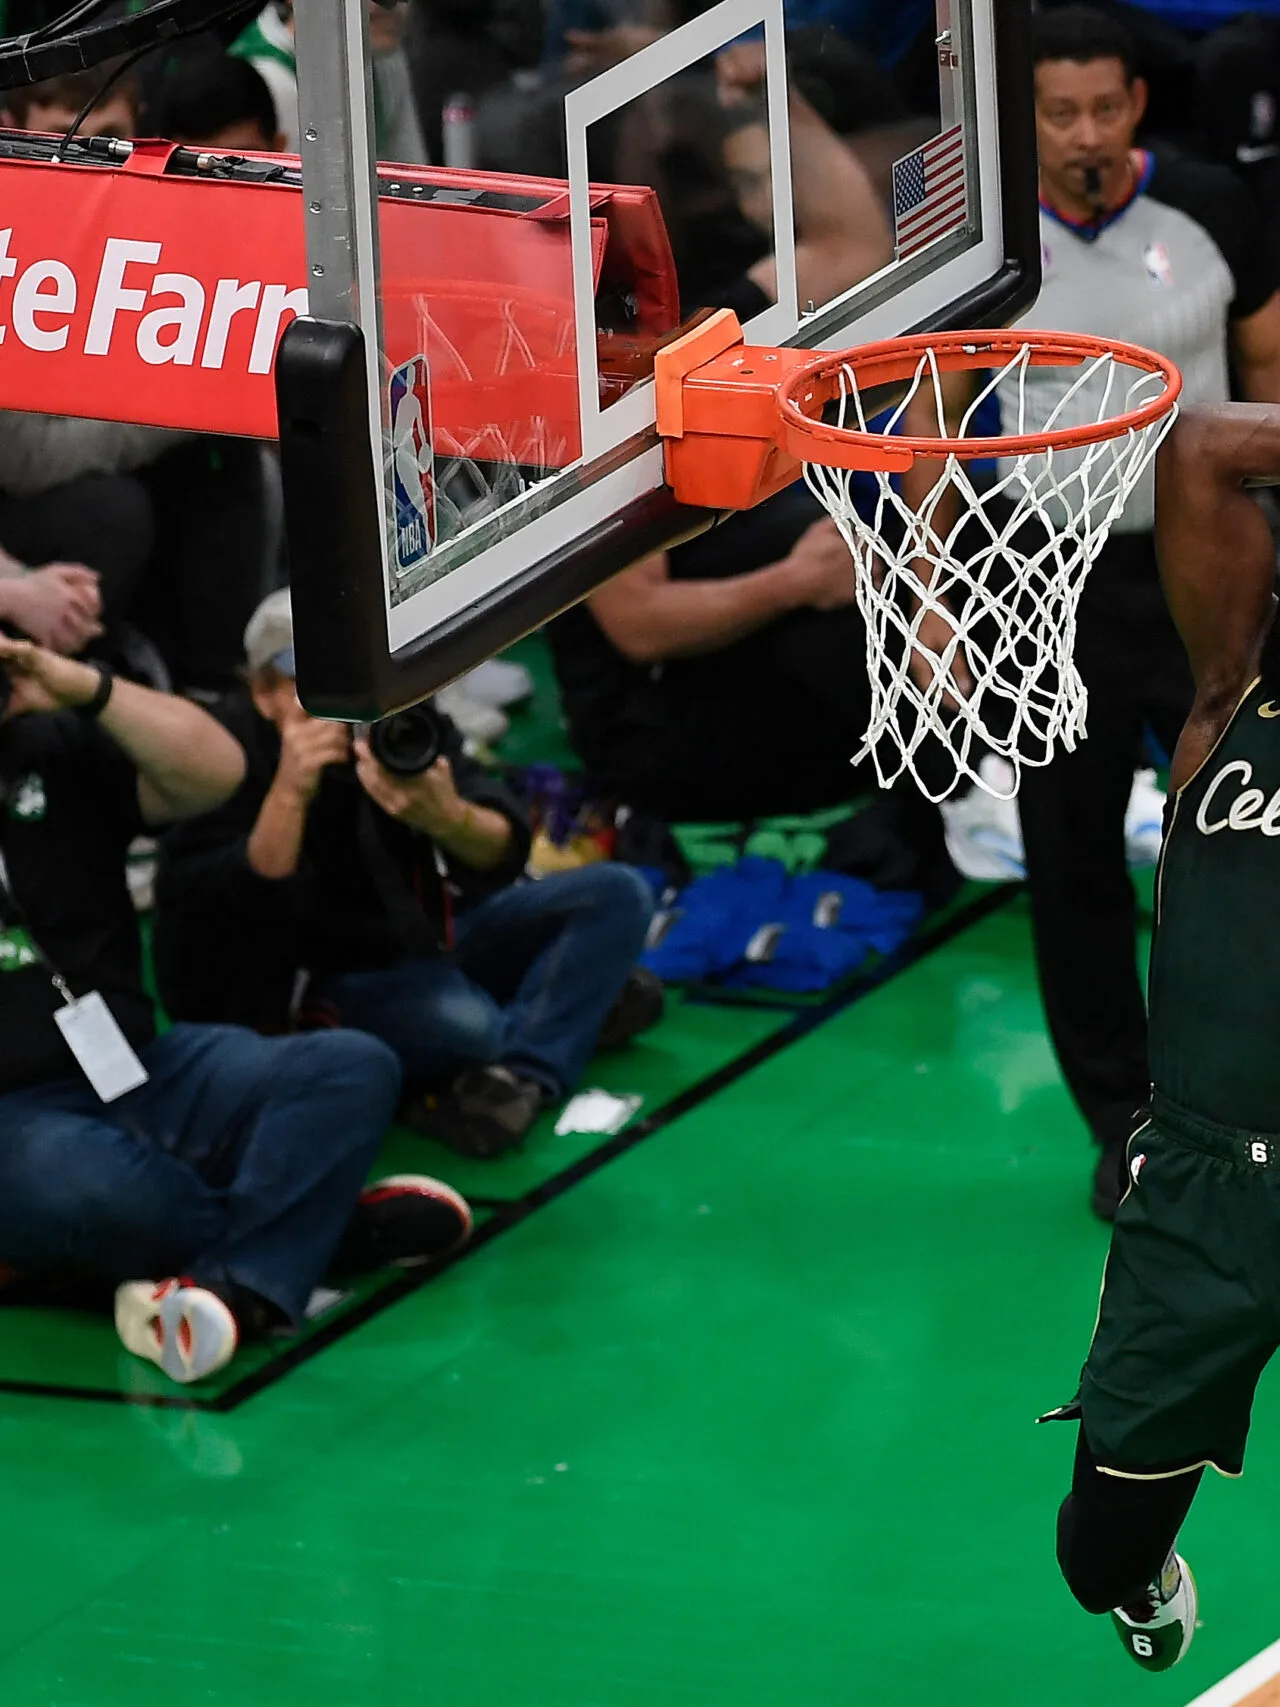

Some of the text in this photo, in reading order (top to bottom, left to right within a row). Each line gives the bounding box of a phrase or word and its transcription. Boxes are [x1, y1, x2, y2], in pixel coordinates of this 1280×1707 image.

[400, 518, 422, 559] NBA
[1251, 1142, 1268, 1163] 6
[1132, 1633, 1153, 1657] 6
